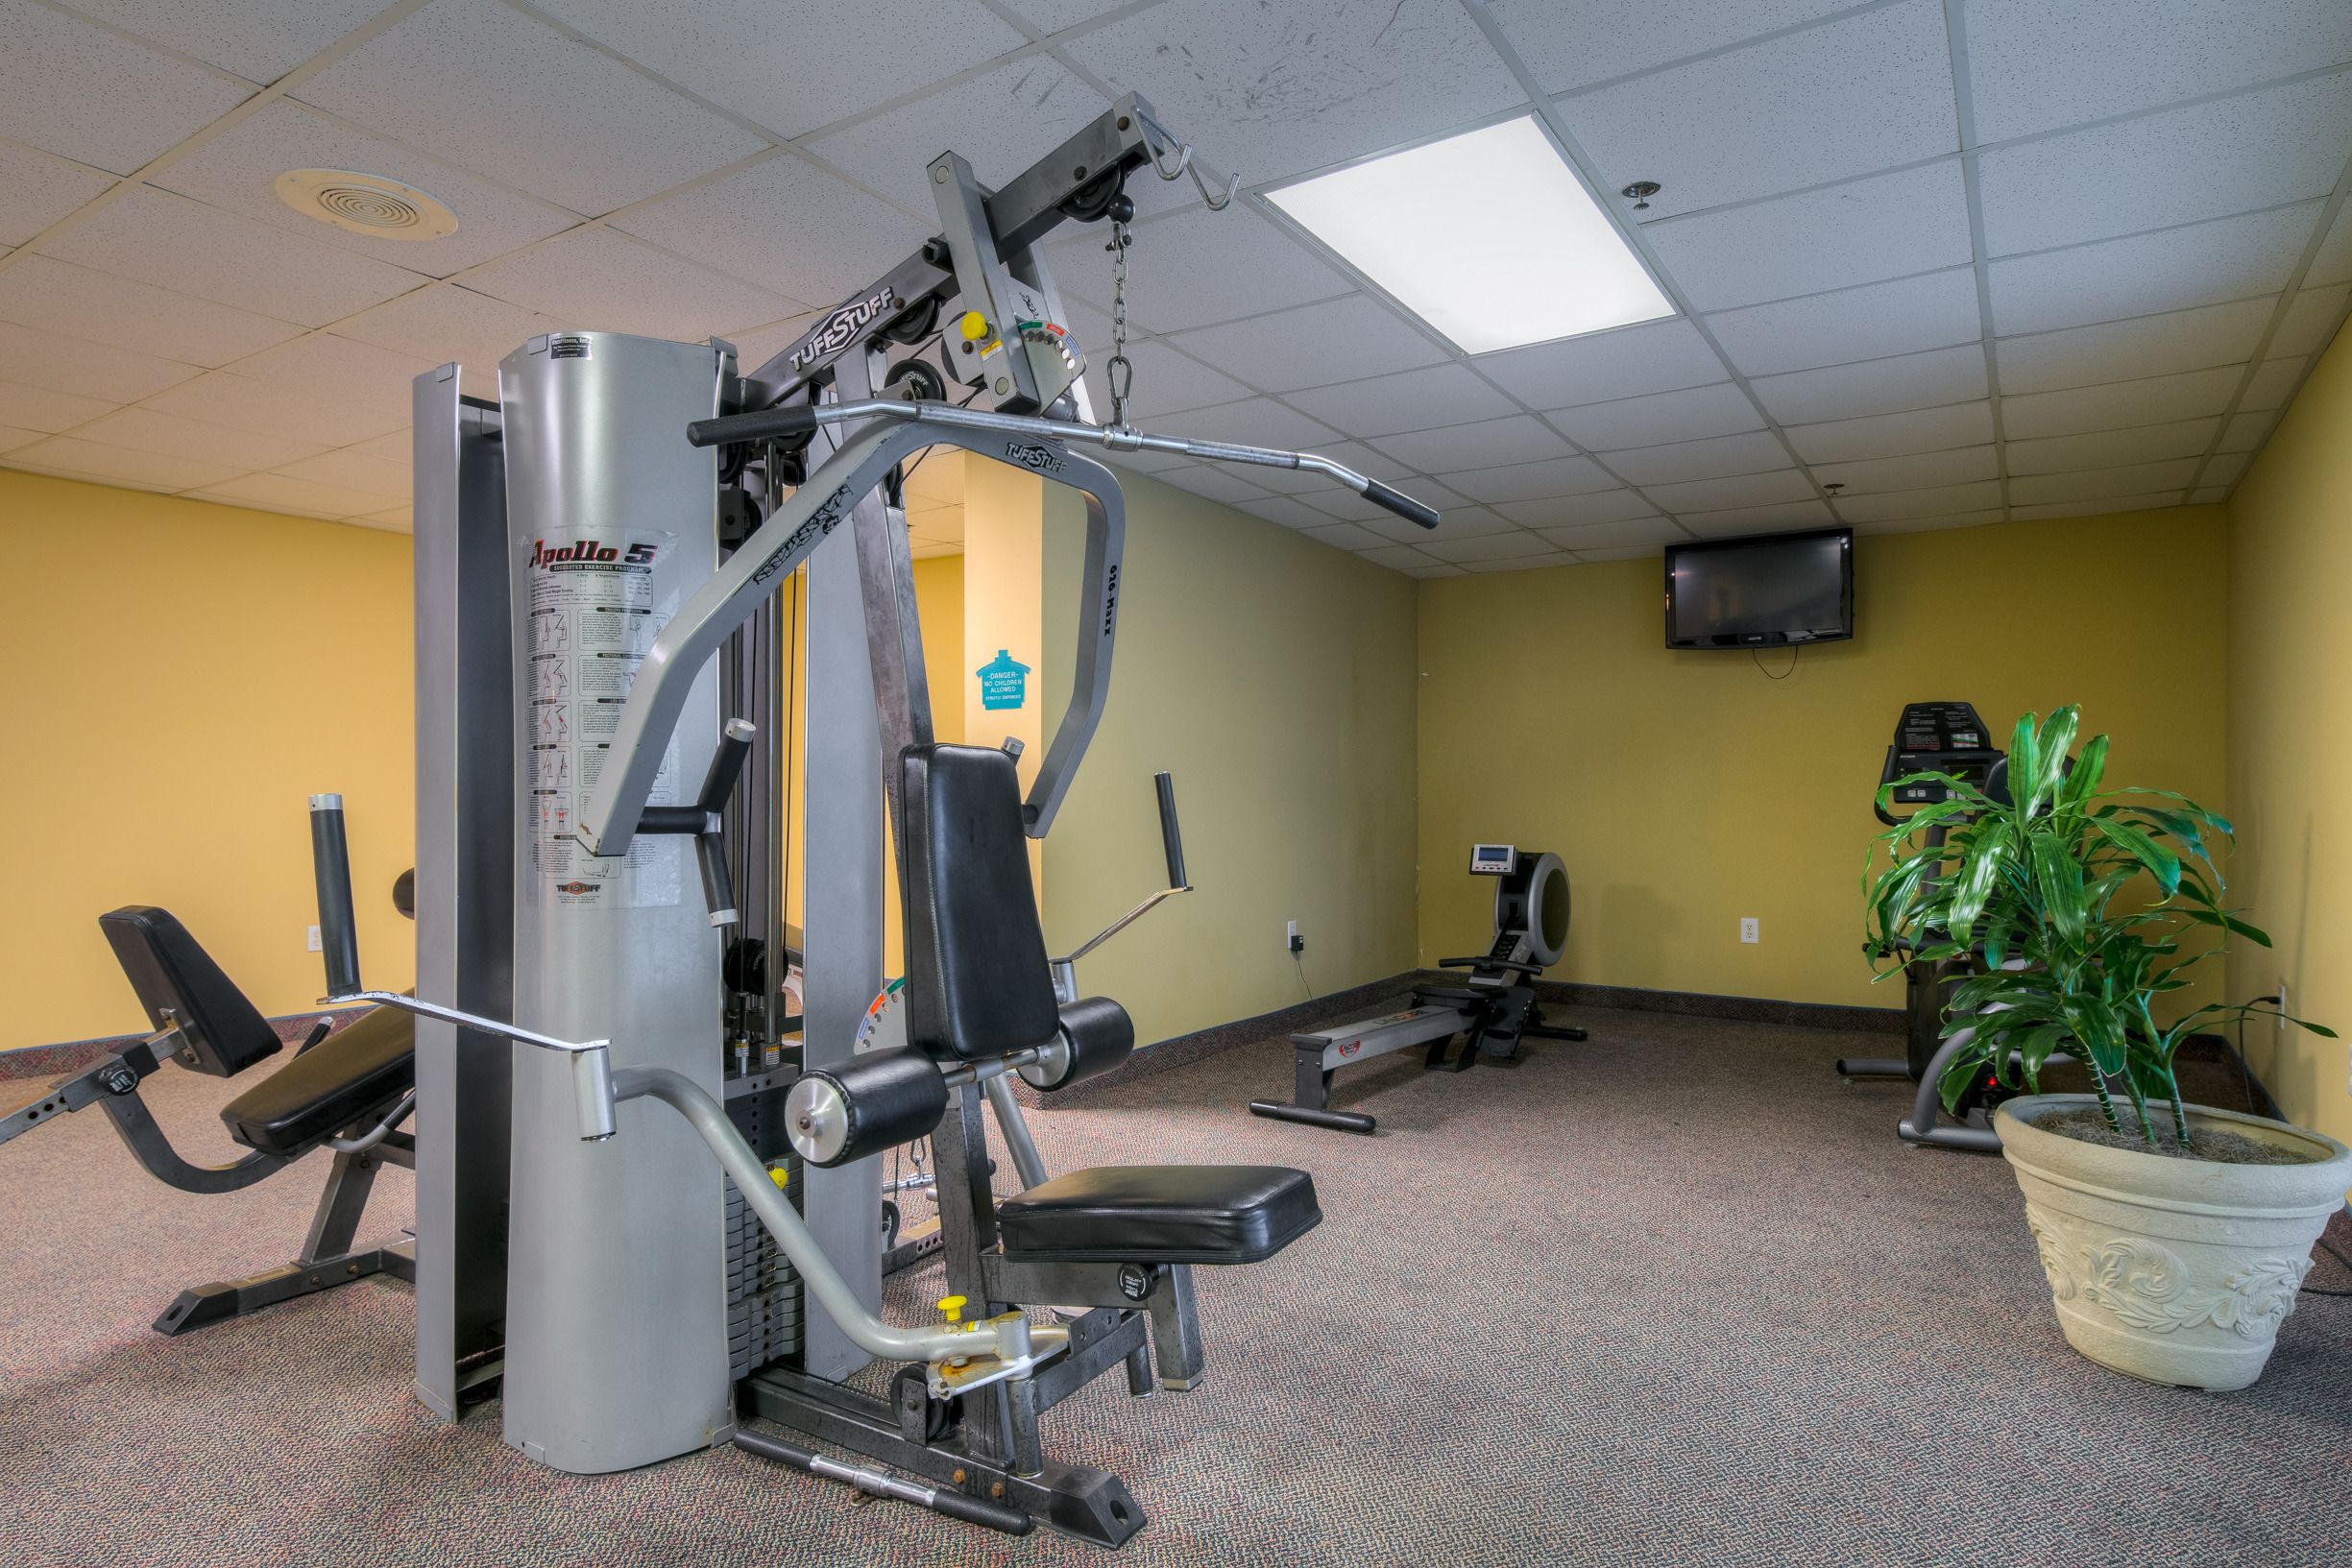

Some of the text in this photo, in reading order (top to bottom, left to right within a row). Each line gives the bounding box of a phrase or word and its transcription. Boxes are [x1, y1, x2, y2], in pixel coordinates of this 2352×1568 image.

[789, 286, 894, 372] TUFFSTUFF
[529, 539, 659, 569] Apollo 5
